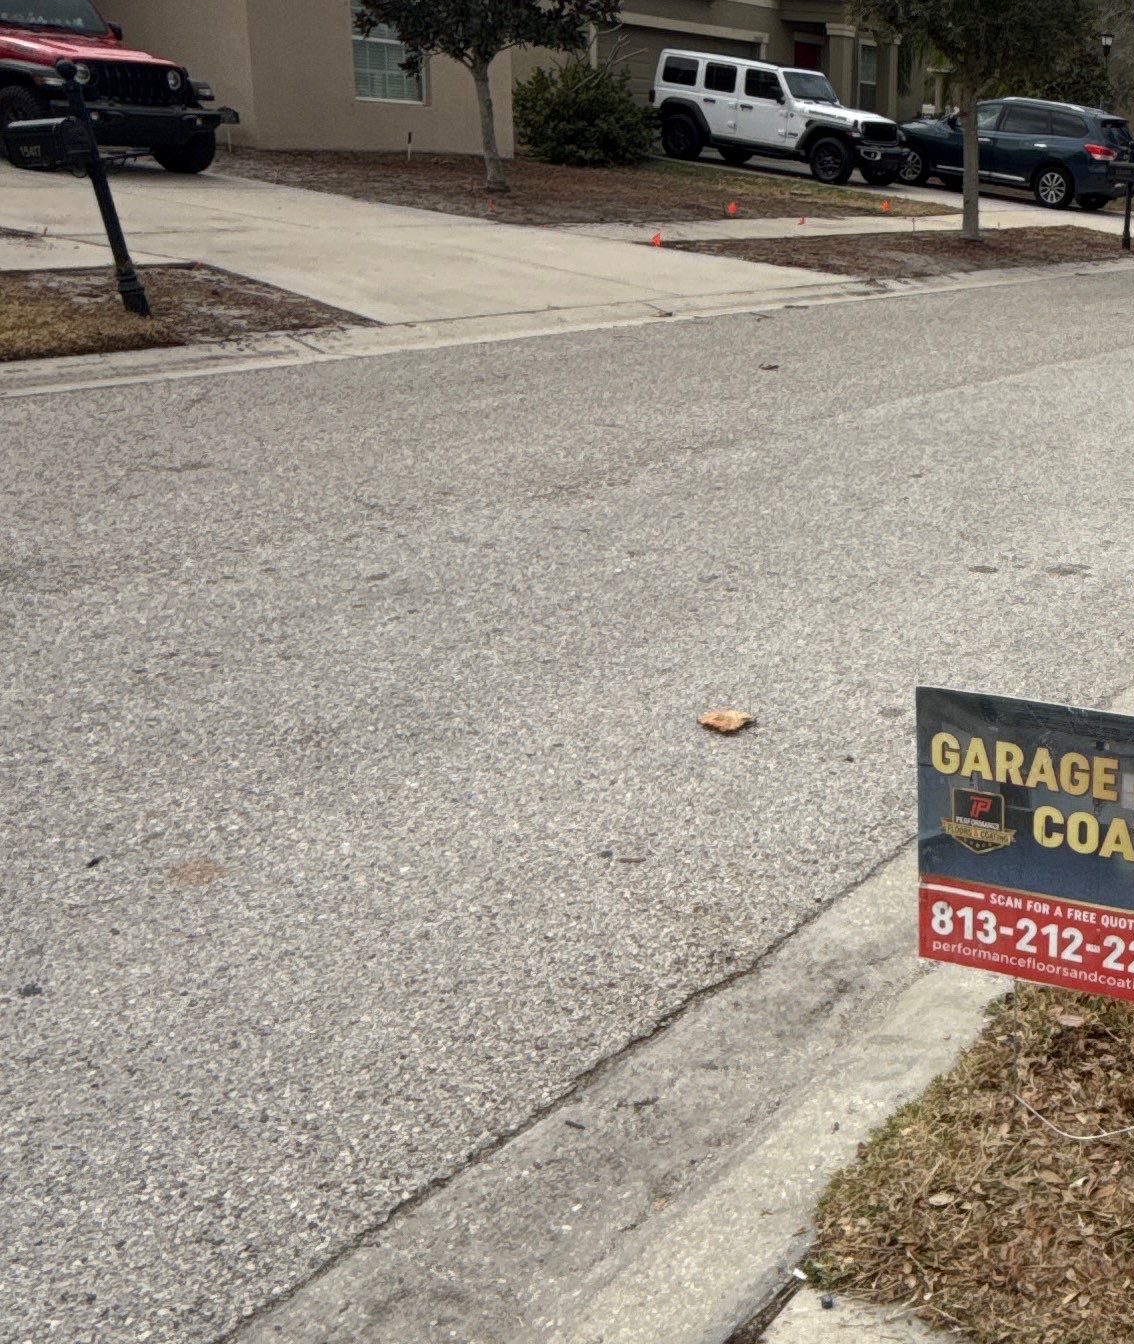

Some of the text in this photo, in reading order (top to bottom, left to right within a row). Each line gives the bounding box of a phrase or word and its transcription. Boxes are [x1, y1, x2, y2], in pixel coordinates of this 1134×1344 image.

[931, 731, 1120, 802] GARAGE
[989, 892, 1023, 910] SCAN
[1026, 900, 1051, 916] FOR
[1053, 906, 1063, 917] A
[1066, 907, 1097, 924] FREE
